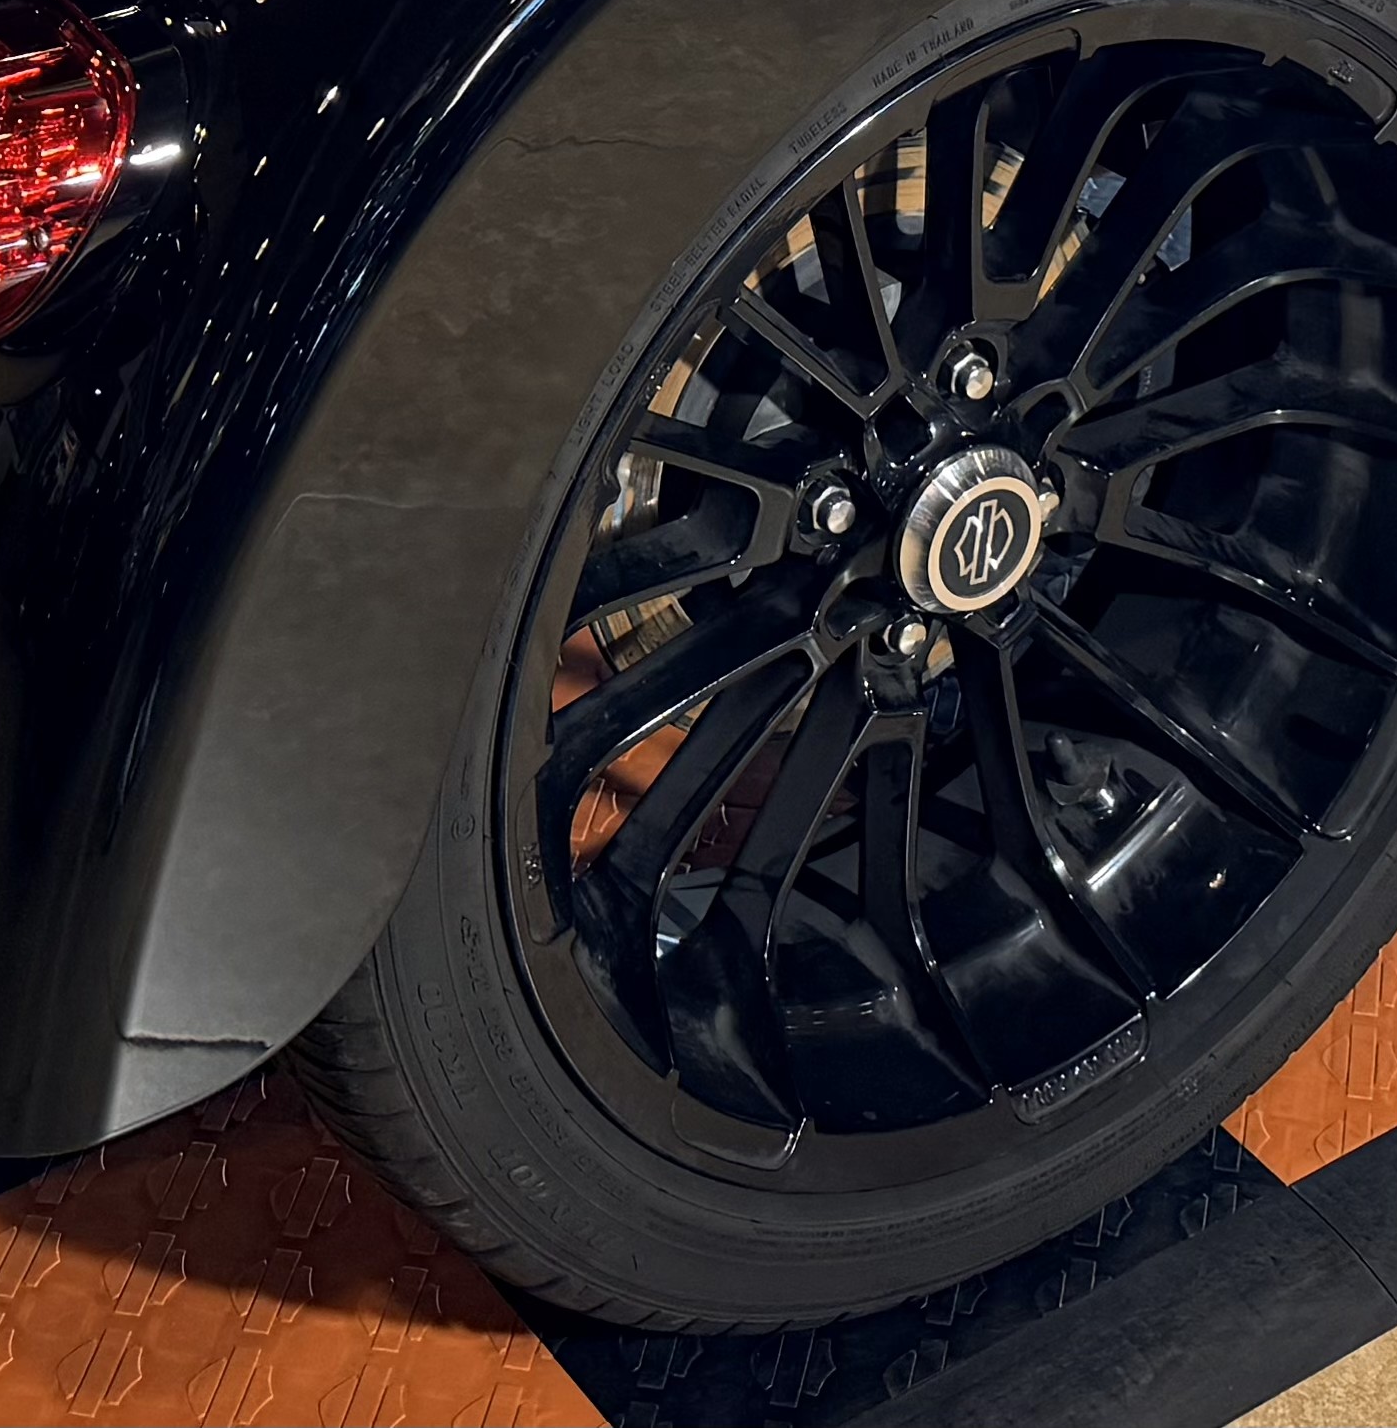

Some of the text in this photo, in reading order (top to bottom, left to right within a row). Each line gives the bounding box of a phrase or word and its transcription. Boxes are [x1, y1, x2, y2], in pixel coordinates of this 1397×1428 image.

[871, 16, 976, 89] MADE IN THAILAND
